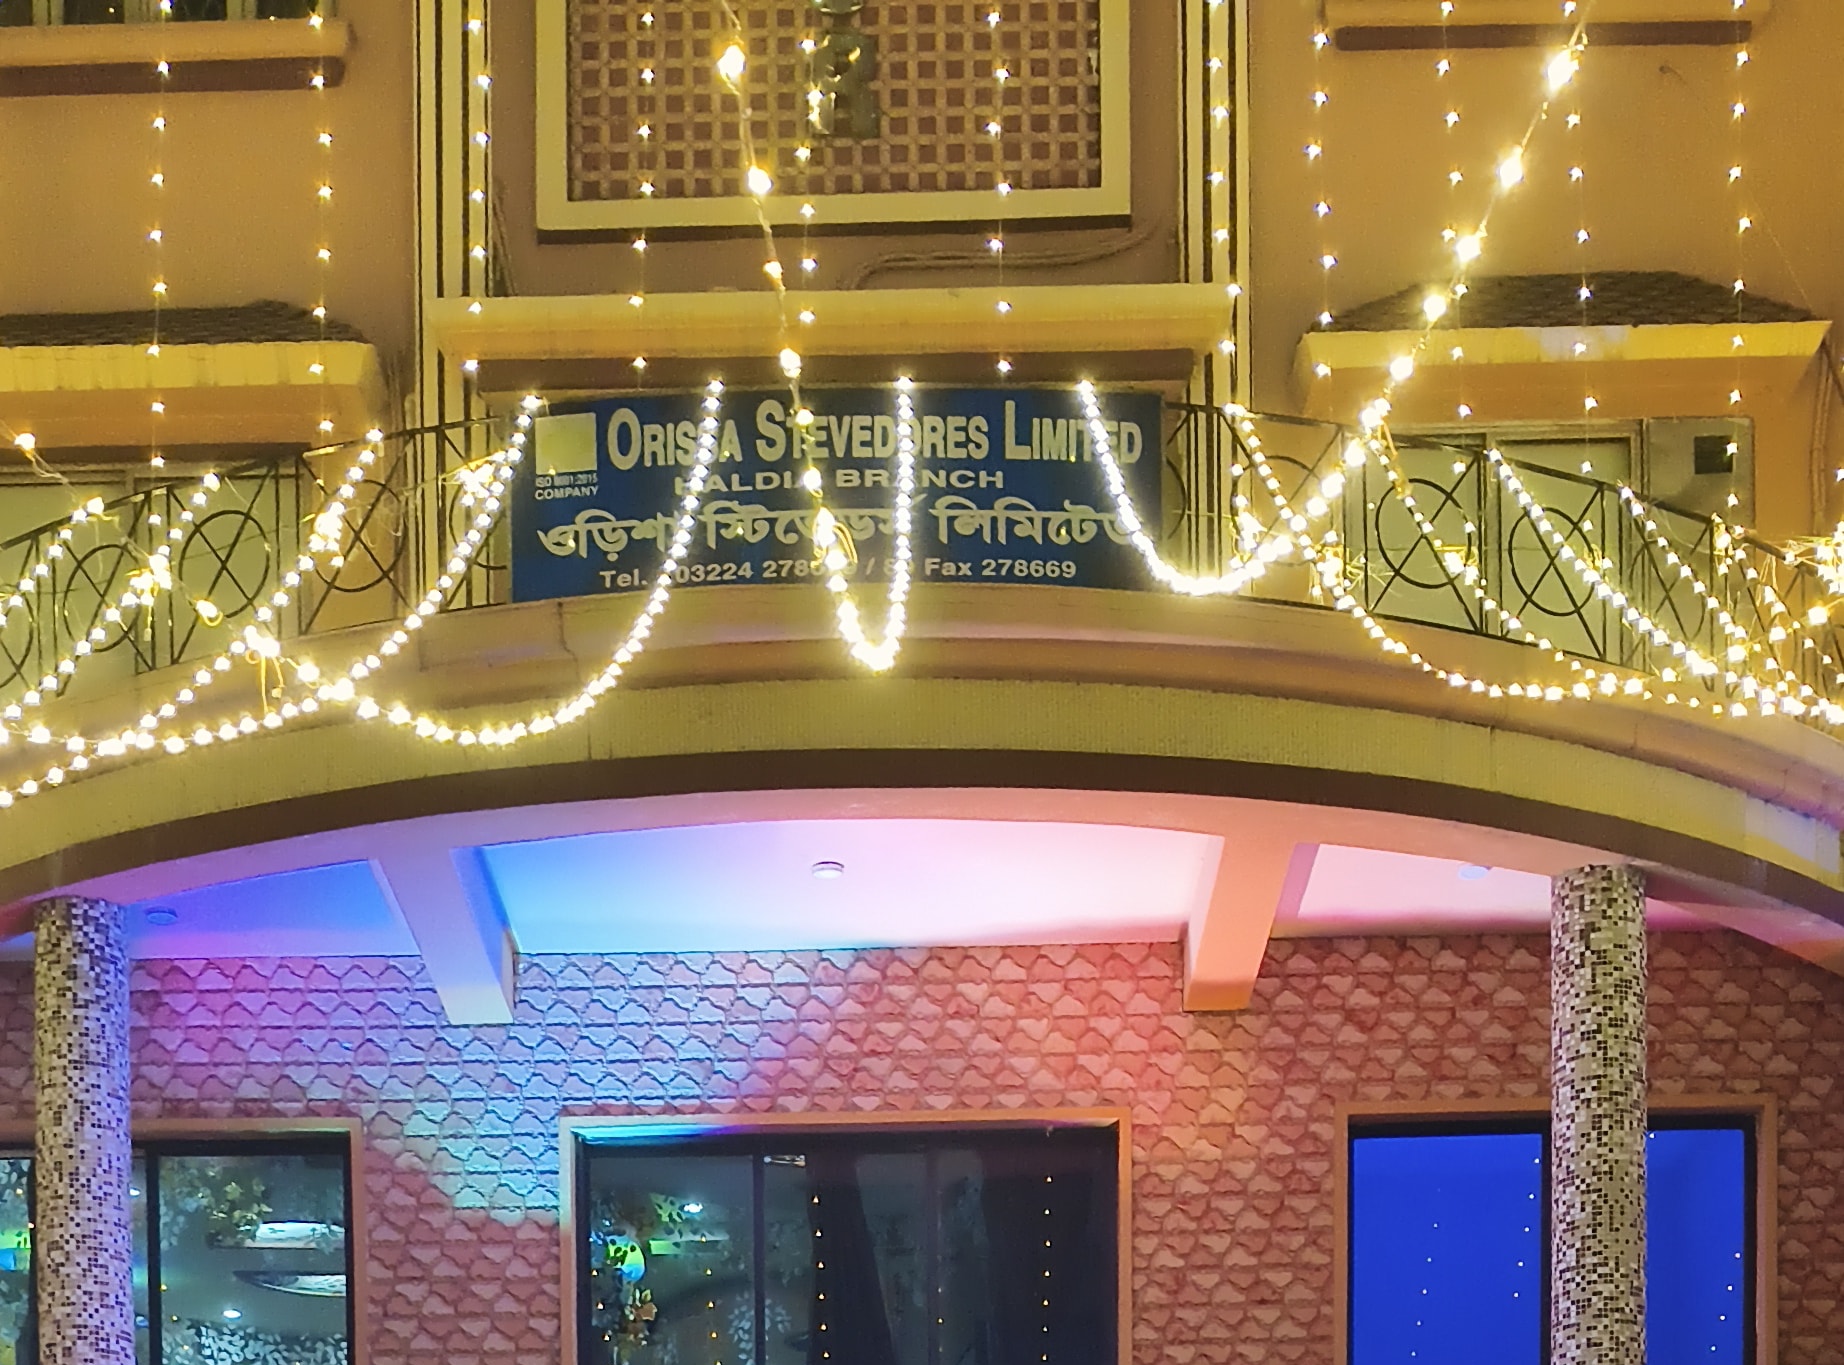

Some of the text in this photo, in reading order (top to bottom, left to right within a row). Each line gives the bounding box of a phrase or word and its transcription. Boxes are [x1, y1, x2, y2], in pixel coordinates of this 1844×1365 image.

[607, 407, 743, 471] ORISA
[535, 485, 598, 500] COMPANY
[674, 468, 1004, 496] HALDI BRNCH
[536, 508, 688, 562] ওড়িশ
[599, 568, 648, 589] Tel.
[675, 561, 754, 584] 03224
[762, 558, 858, 579] 278
[924, 557, 972, 576] Fax
[981, 558, 1077, 578] 278669
